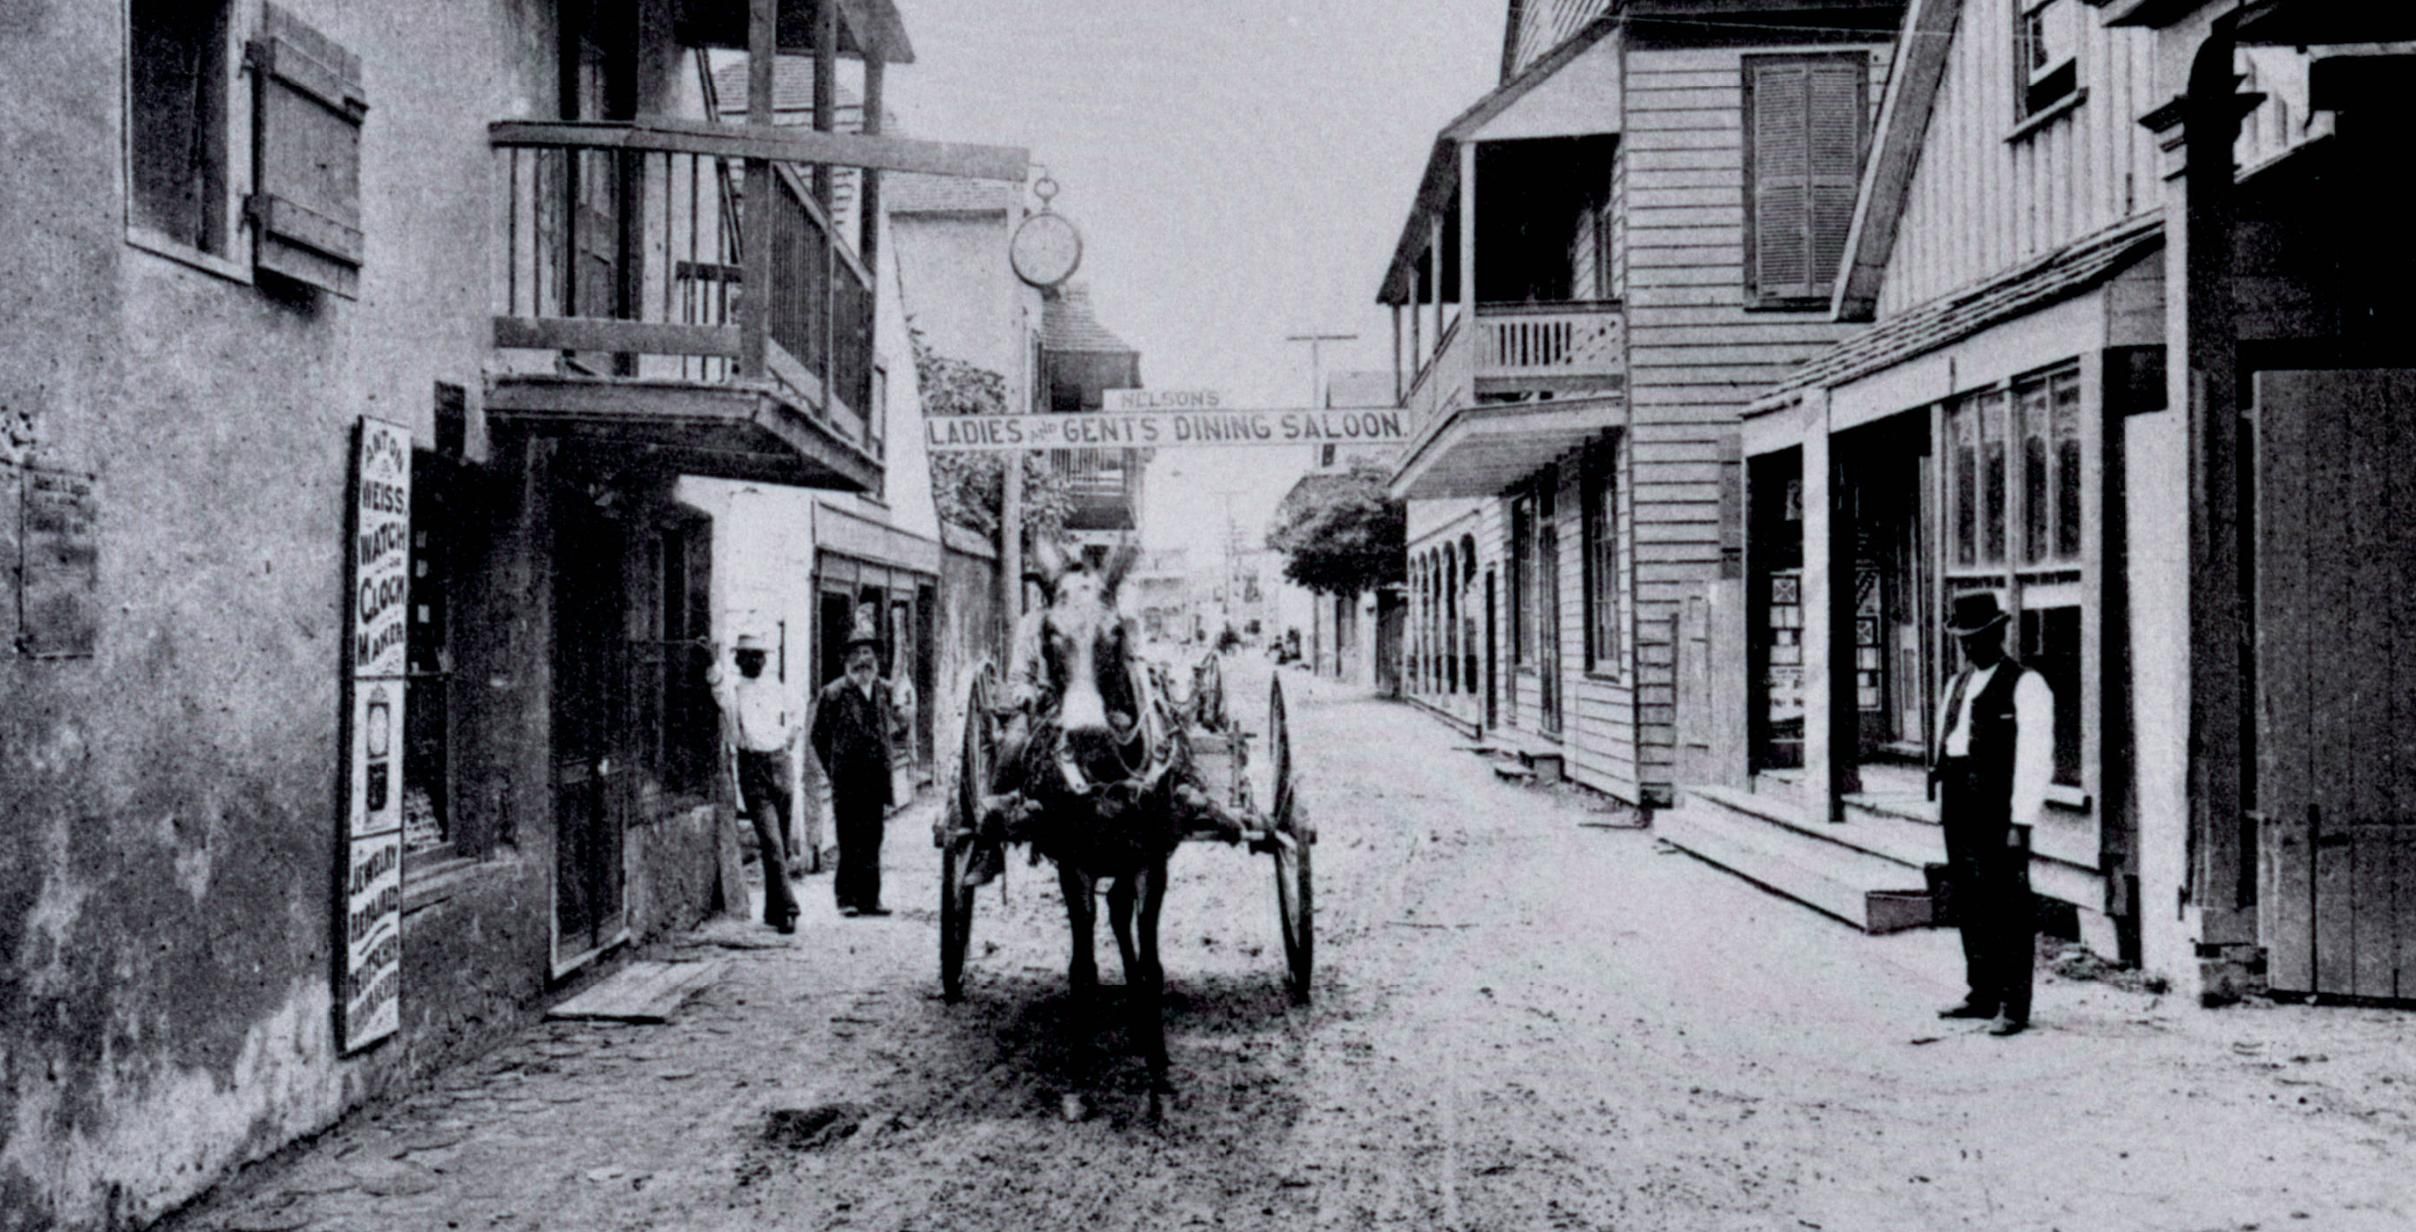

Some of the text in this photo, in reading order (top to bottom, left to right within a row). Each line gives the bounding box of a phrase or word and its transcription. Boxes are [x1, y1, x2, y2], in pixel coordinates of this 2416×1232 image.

[365, 429, 403, 472] ANTON
[928, 411, 1409, 446] LADIES AND GENTS DINING SALOON.
[360, 521, 405, 566] WATCH
[360, 575, 404, 625] CLOCK
[358, 621, 404, 667] MAKER
